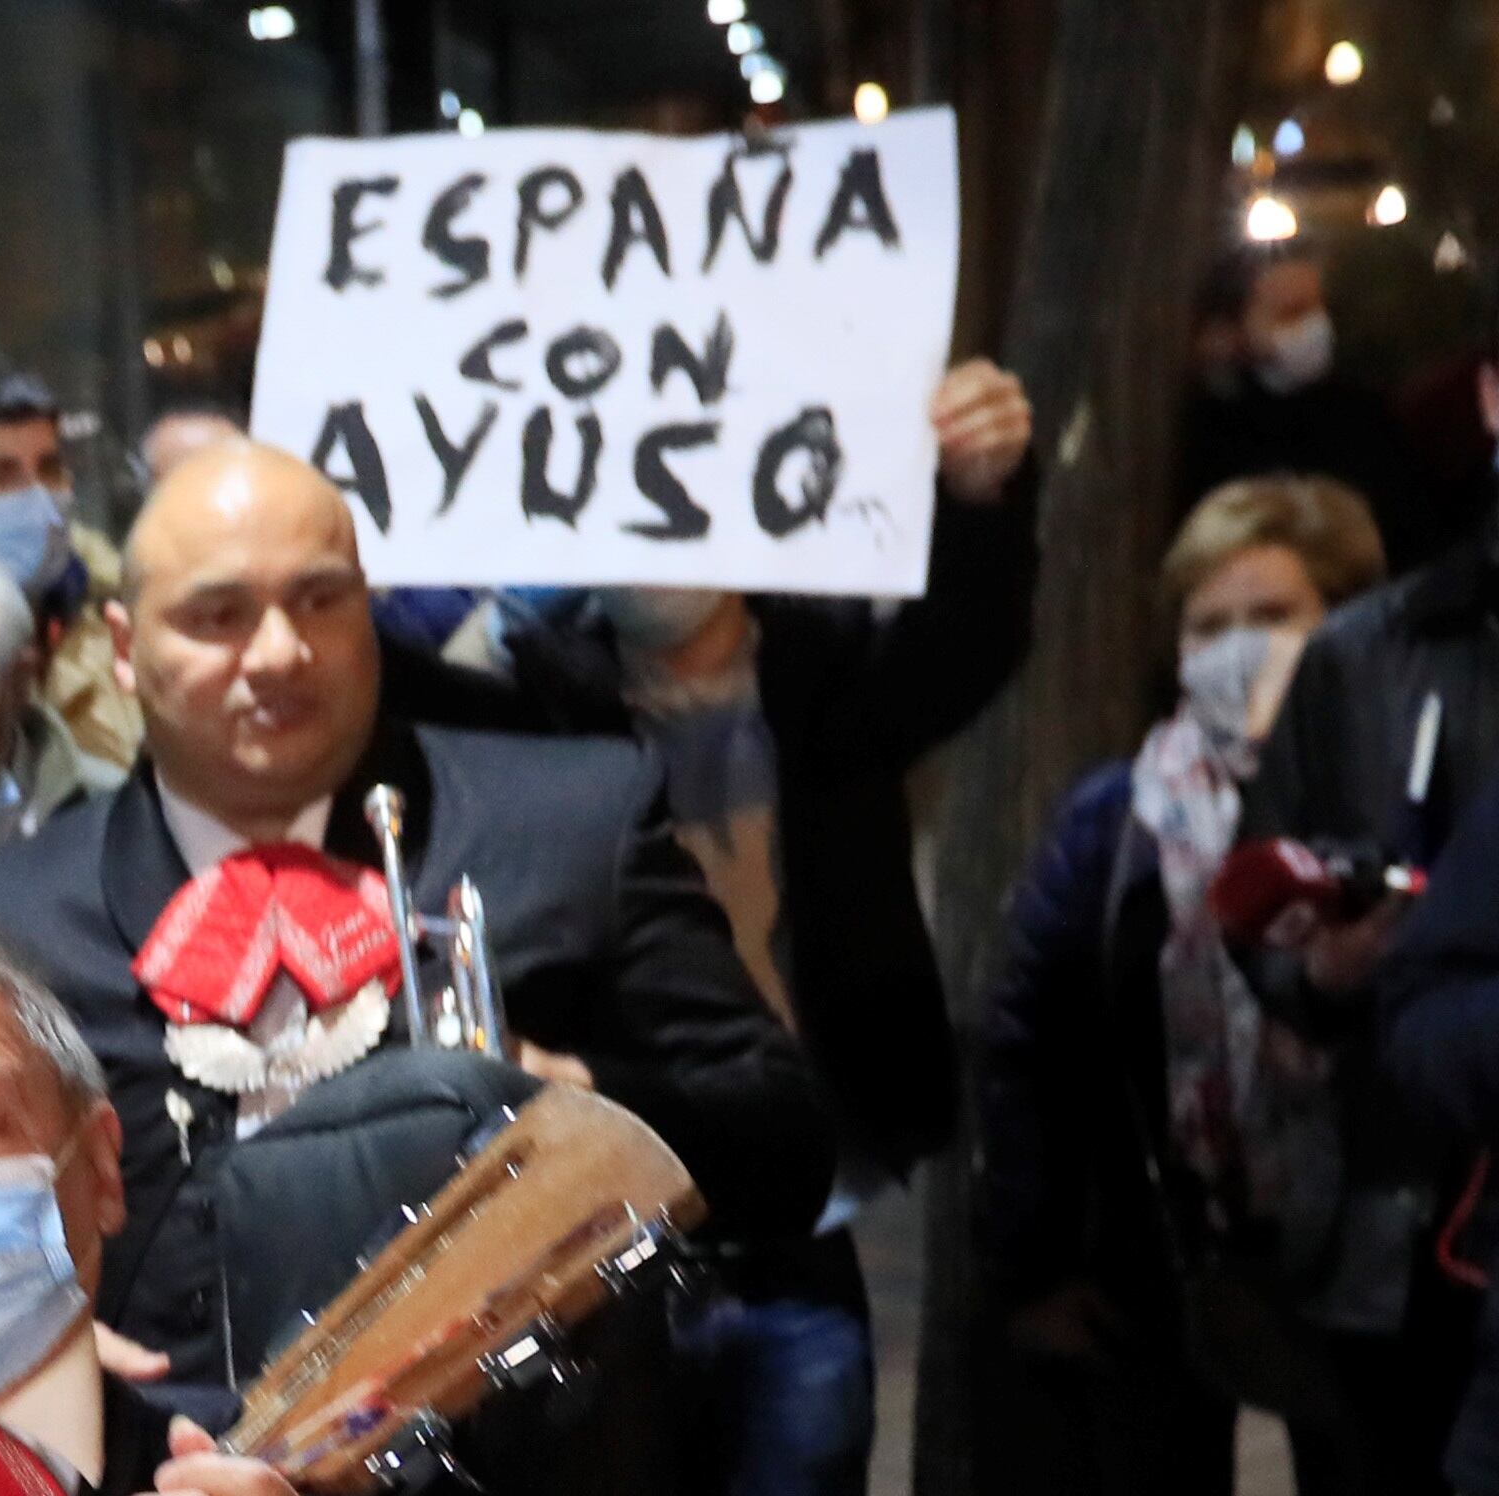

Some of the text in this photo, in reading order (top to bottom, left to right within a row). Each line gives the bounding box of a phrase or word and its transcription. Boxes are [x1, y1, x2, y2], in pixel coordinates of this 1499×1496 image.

[322, 130, 902, 299] ESPAÑA
[458, 309, 739, 404] CON
[311, 396, 846, 540] AYUSO
